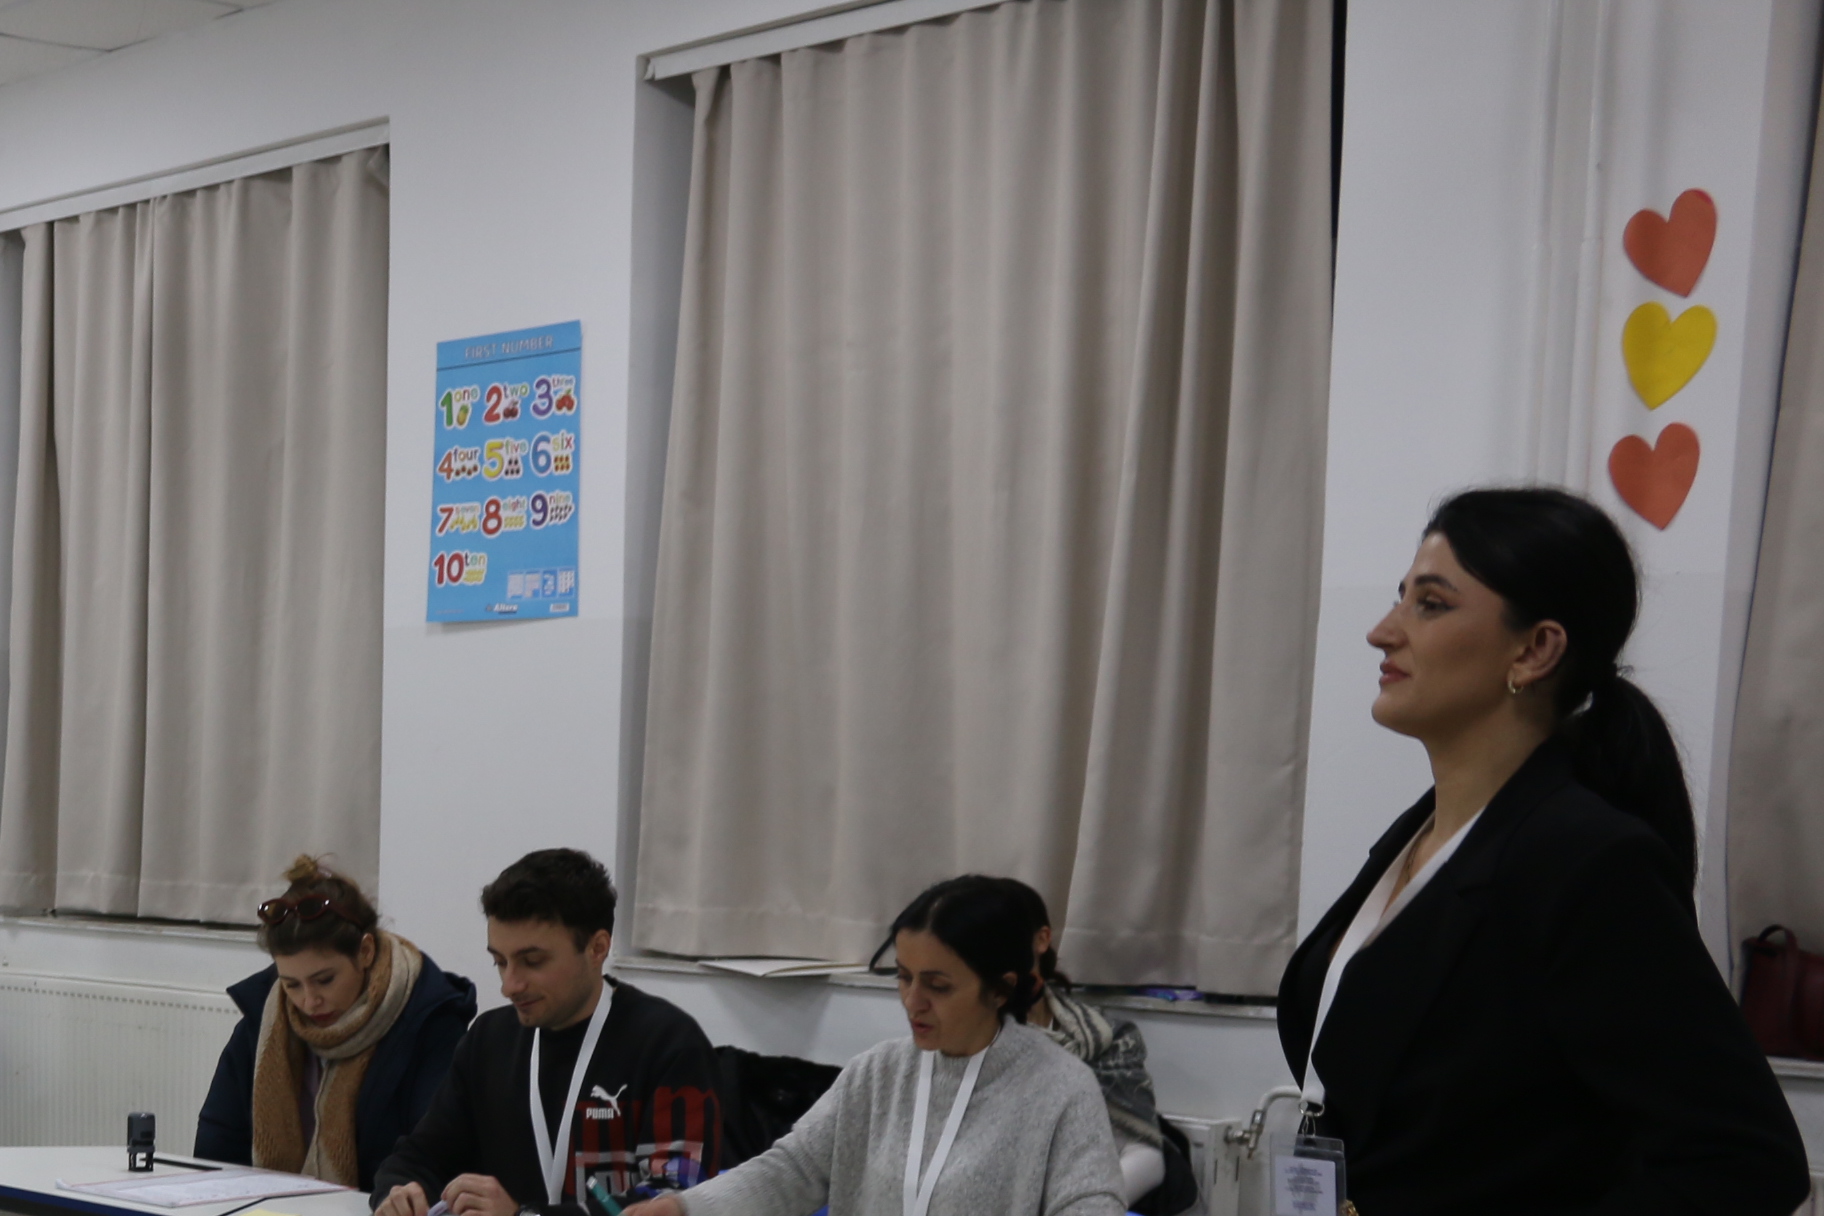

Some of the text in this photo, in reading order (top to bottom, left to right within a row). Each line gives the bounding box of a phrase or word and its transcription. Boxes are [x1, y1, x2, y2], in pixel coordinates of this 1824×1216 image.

[465, 335, 554, 359] FIRST NUMBER
[440, 387, 479, 427] 1 one
[484, 384, 528, 423] 2 two
[532, 378, 553, 416] 3
[438, 448, 478, 480] 4 four
[484, 441, 504, 478] 5
[532, 432, 573, 474] 6 six
[438, 506, 454, 533] 7
[482, 498, 502, 535] 8
[531, 494, 548, 527] 9
[434, 552, 486, 585] 10 ten
[586, 1107, 614, 1120] PUMA
